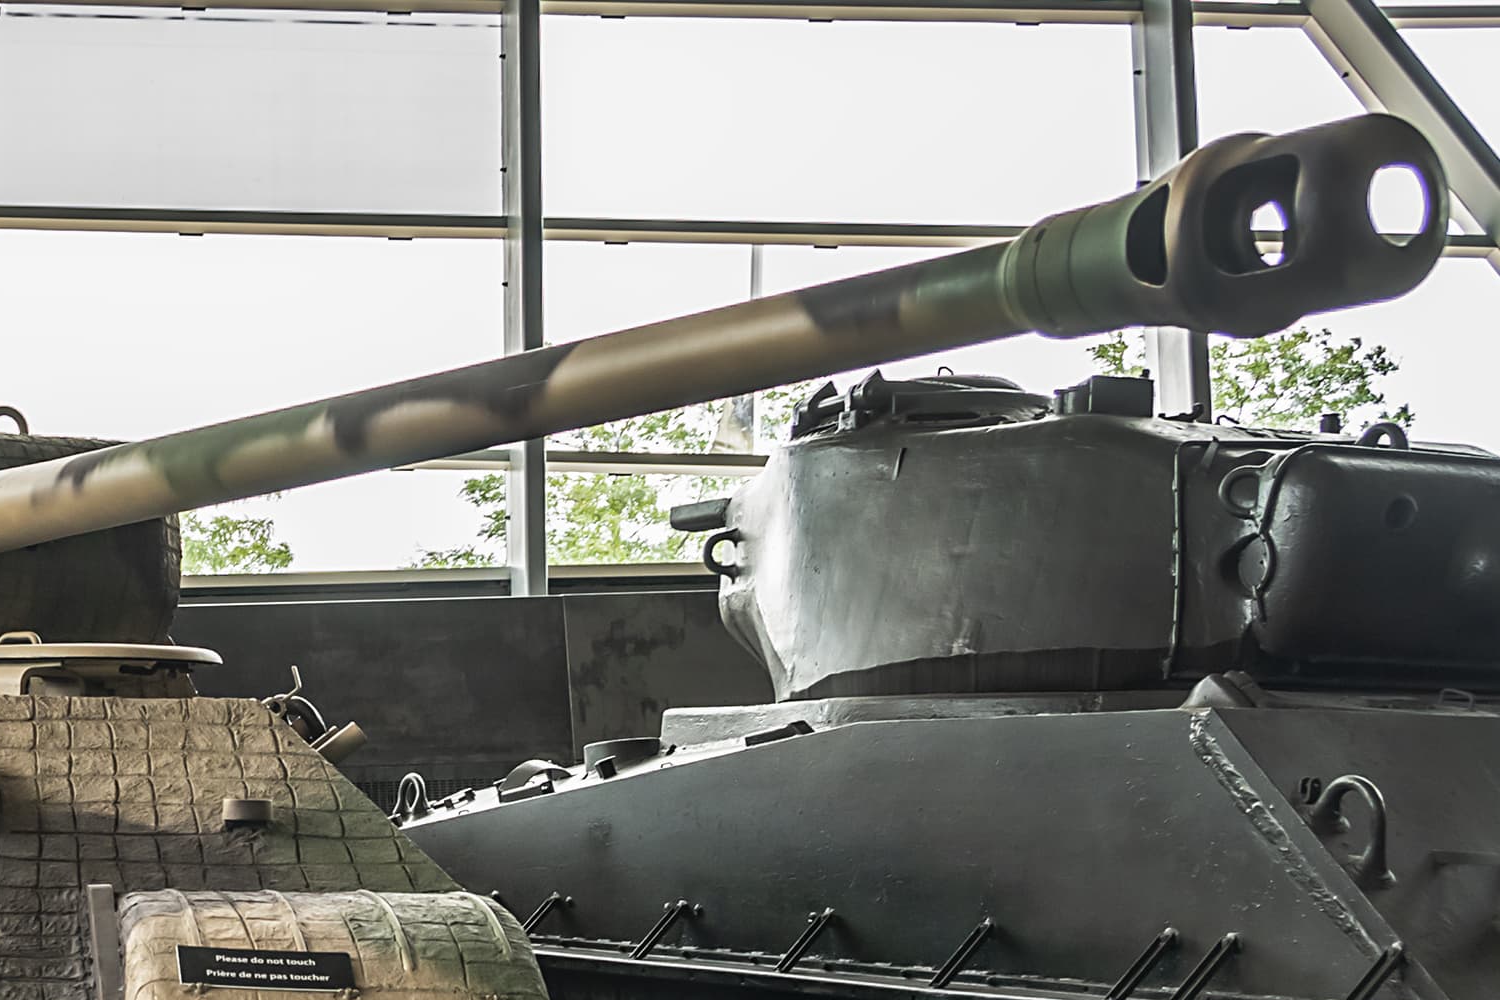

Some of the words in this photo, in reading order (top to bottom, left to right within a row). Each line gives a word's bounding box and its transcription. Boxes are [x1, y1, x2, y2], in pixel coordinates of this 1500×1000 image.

[216, 954, 248, 963] Please
[287, 958, 316, 966] touch
[206, 969, 236, 977] Prière
[290, 973, 330, 982] toucher
